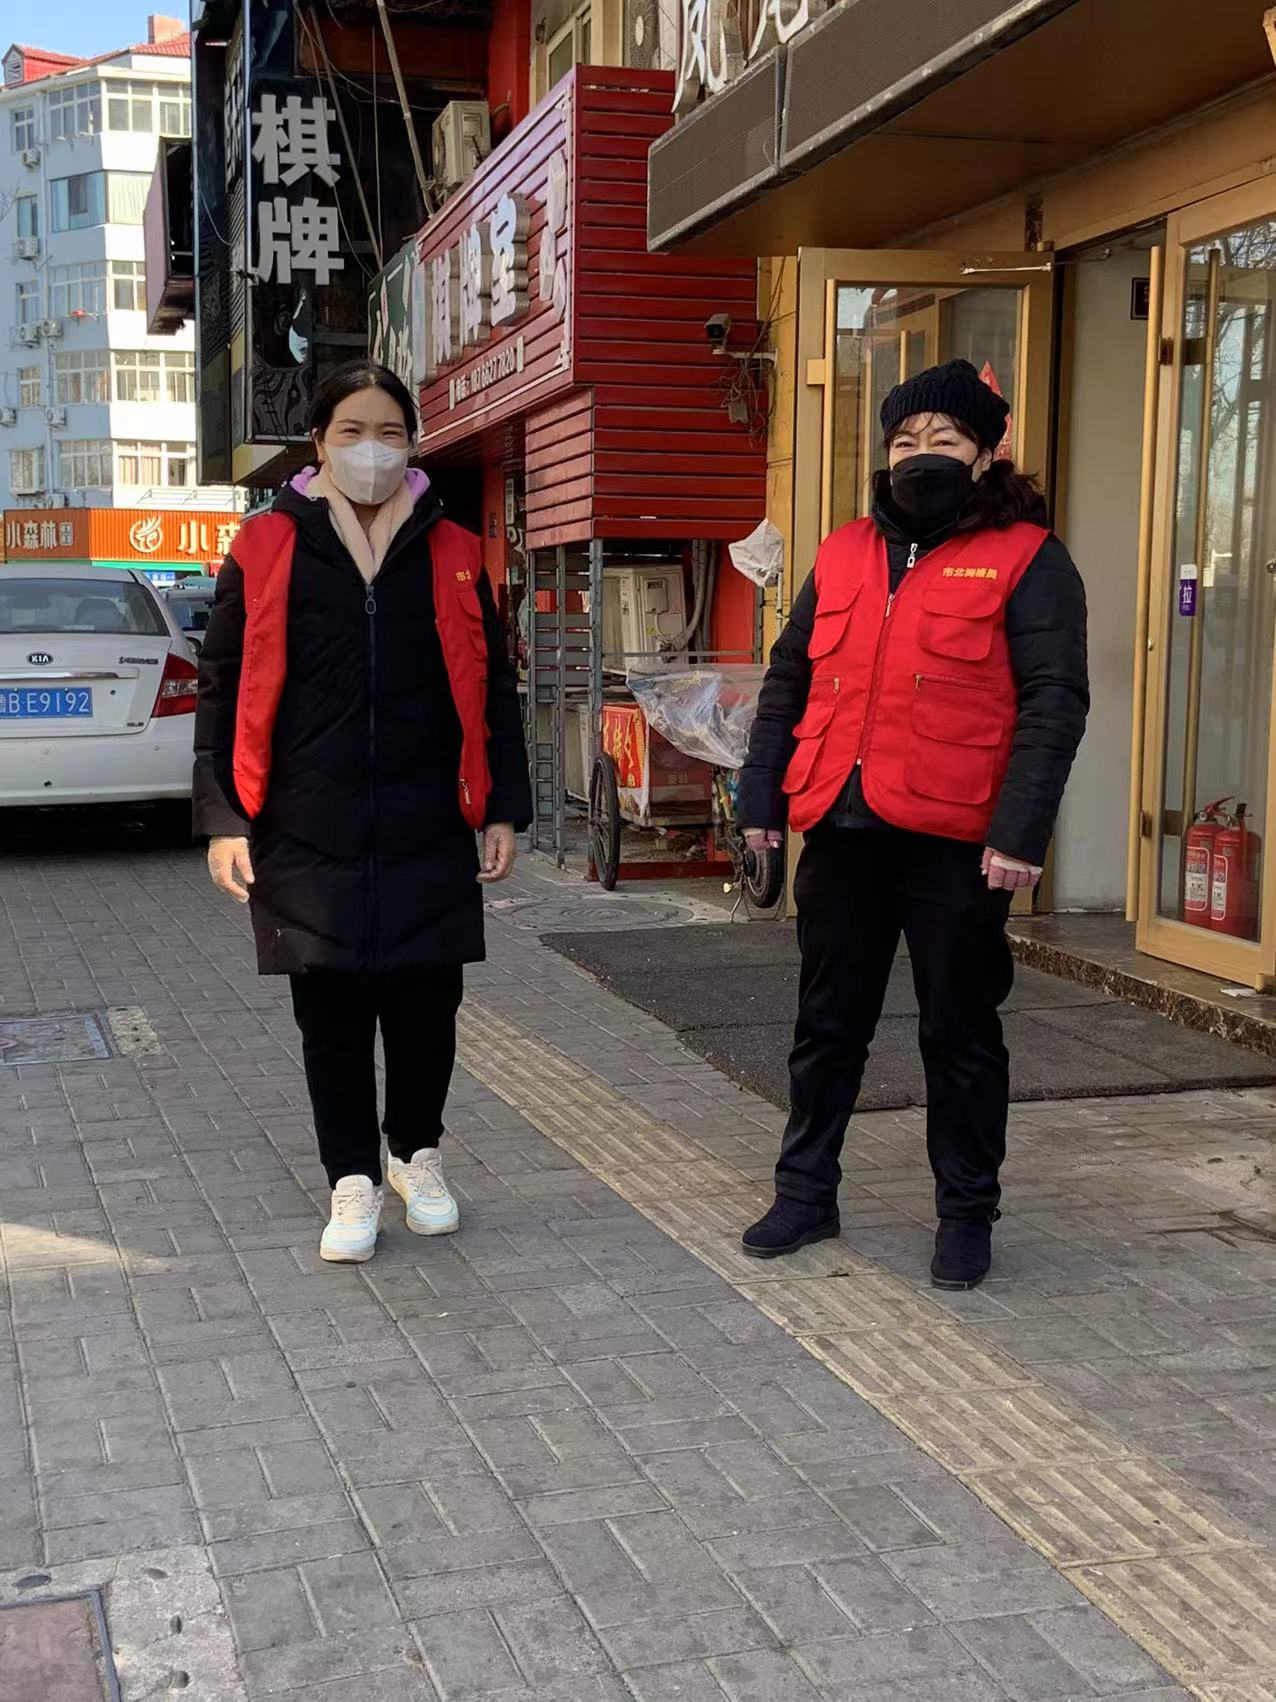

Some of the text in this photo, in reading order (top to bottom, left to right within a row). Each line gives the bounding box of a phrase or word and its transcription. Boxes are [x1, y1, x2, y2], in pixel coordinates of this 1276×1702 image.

[252, 94, 344, 286] 棋牌
[6, 520, 58, 549] 小森林
[31, 652, 49, 663] KIA
